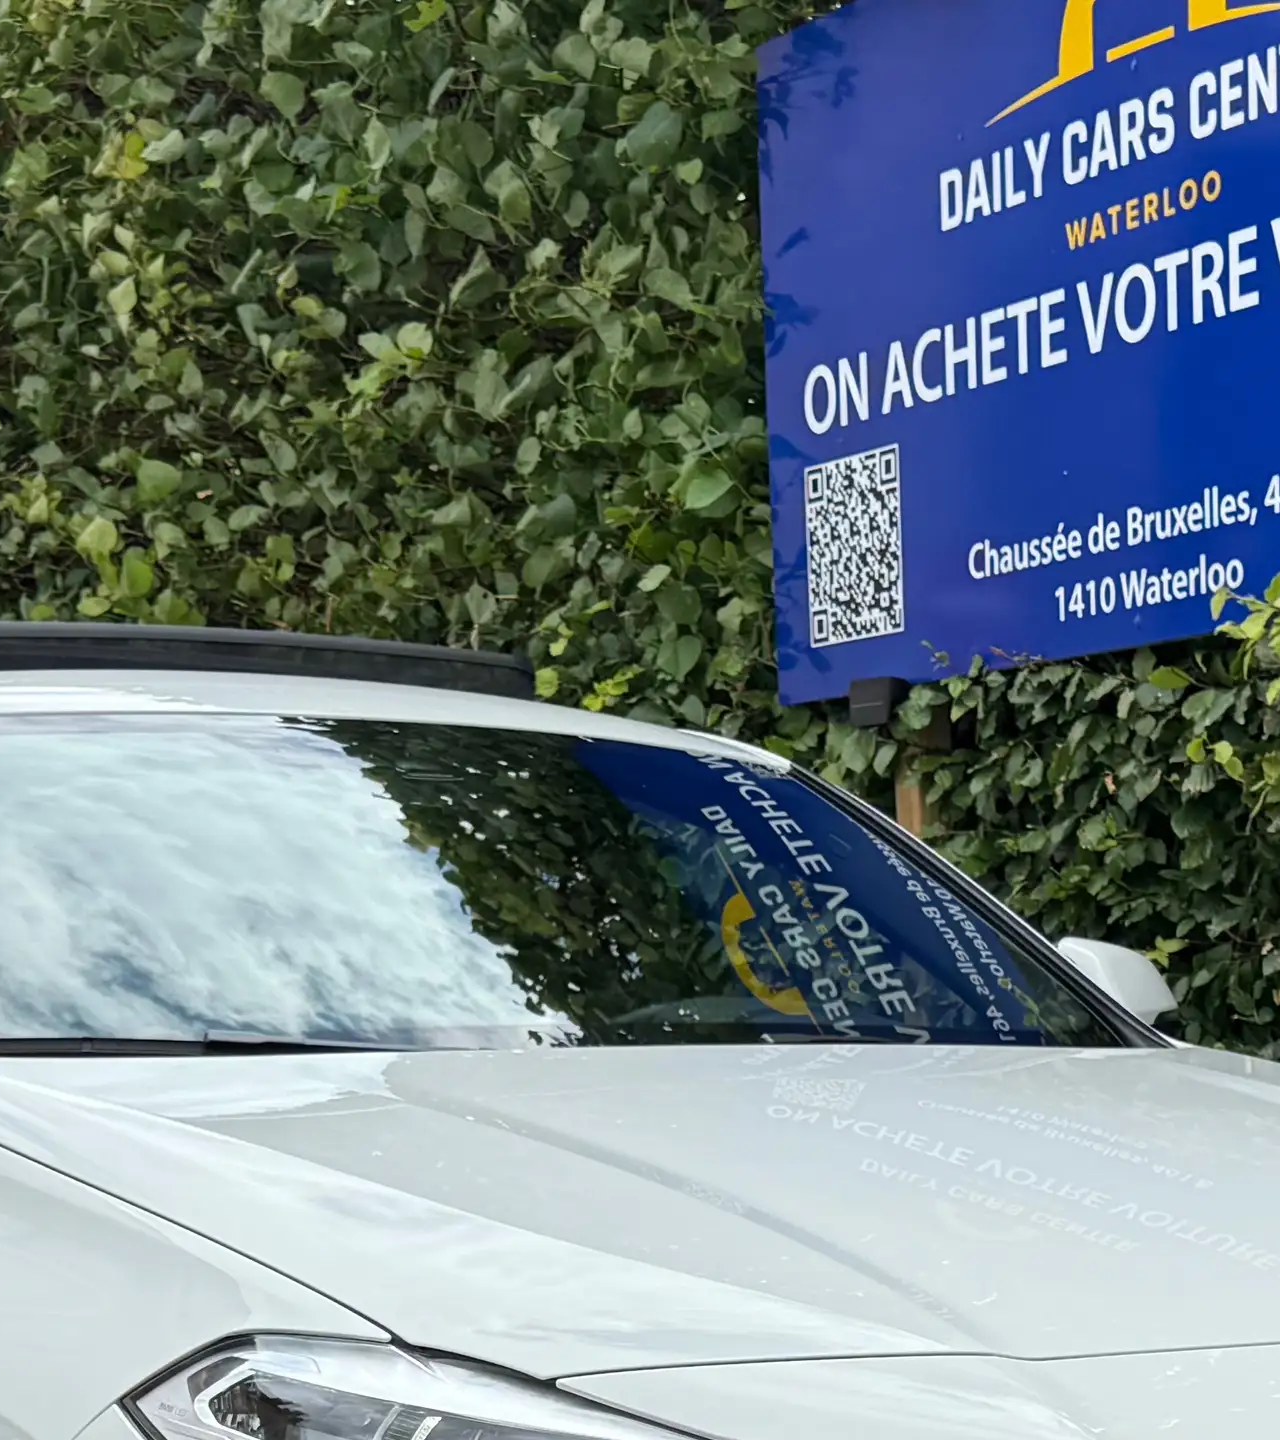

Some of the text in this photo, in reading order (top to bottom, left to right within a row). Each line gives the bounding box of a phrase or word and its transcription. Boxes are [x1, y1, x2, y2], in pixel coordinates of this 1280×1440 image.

[939, 131, 1050, 232] DAILY
[1062, 87, 1176, 186] CARS
[1064, 170, 1221, 251] WATERLOO
[803, 352, 869, 435] ON
[882, 285, 1068, 414] ACHETE
[1076, 224, 1260, 355] VOTRE
[967, 522, 1082, 580] Chaussée
[1087, 513, 1120, 555] de
[1126, 485, 1259, 547] Bruxelles,
[1054, 553, 1244, 622] 1410 Waterloo
